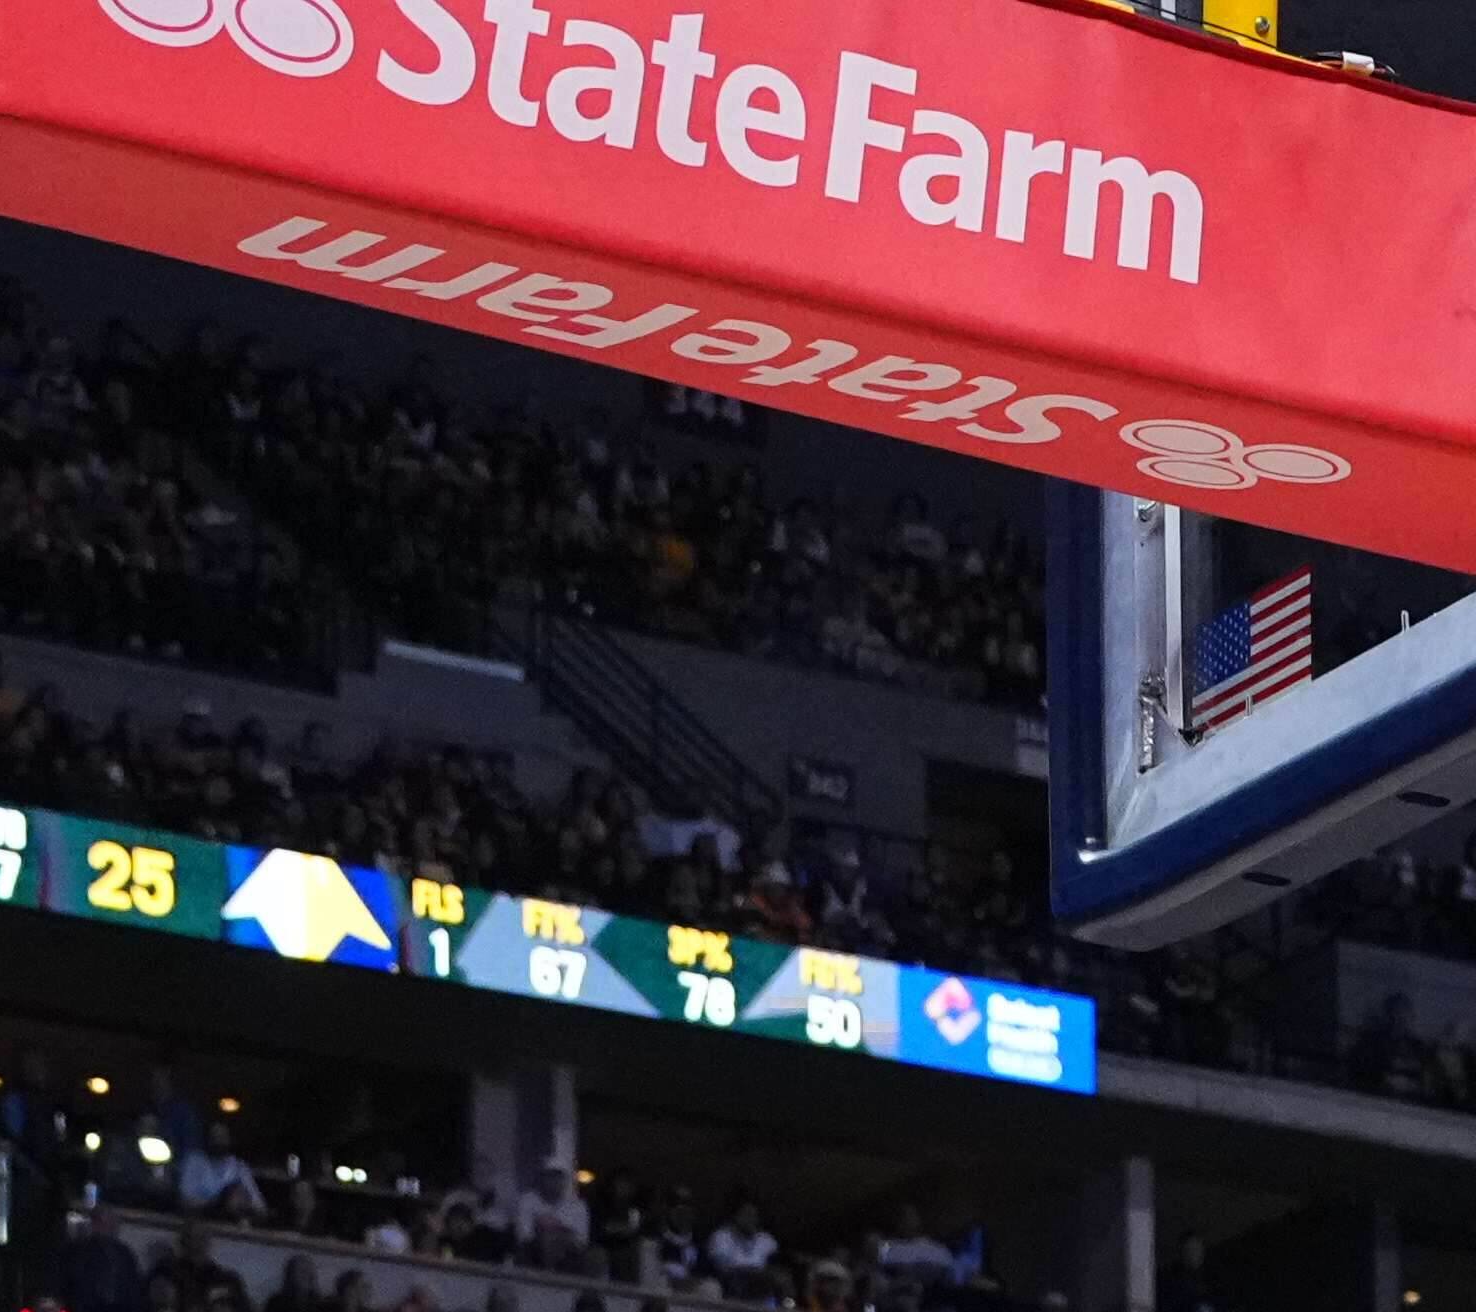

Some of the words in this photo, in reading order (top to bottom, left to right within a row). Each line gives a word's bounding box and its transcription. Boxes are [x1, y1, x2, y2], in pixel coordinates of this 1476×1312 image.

[86, 839, 175, 918] 25
[428, 927, 451, 978] 1
[529, 945, 588, 999] 67
